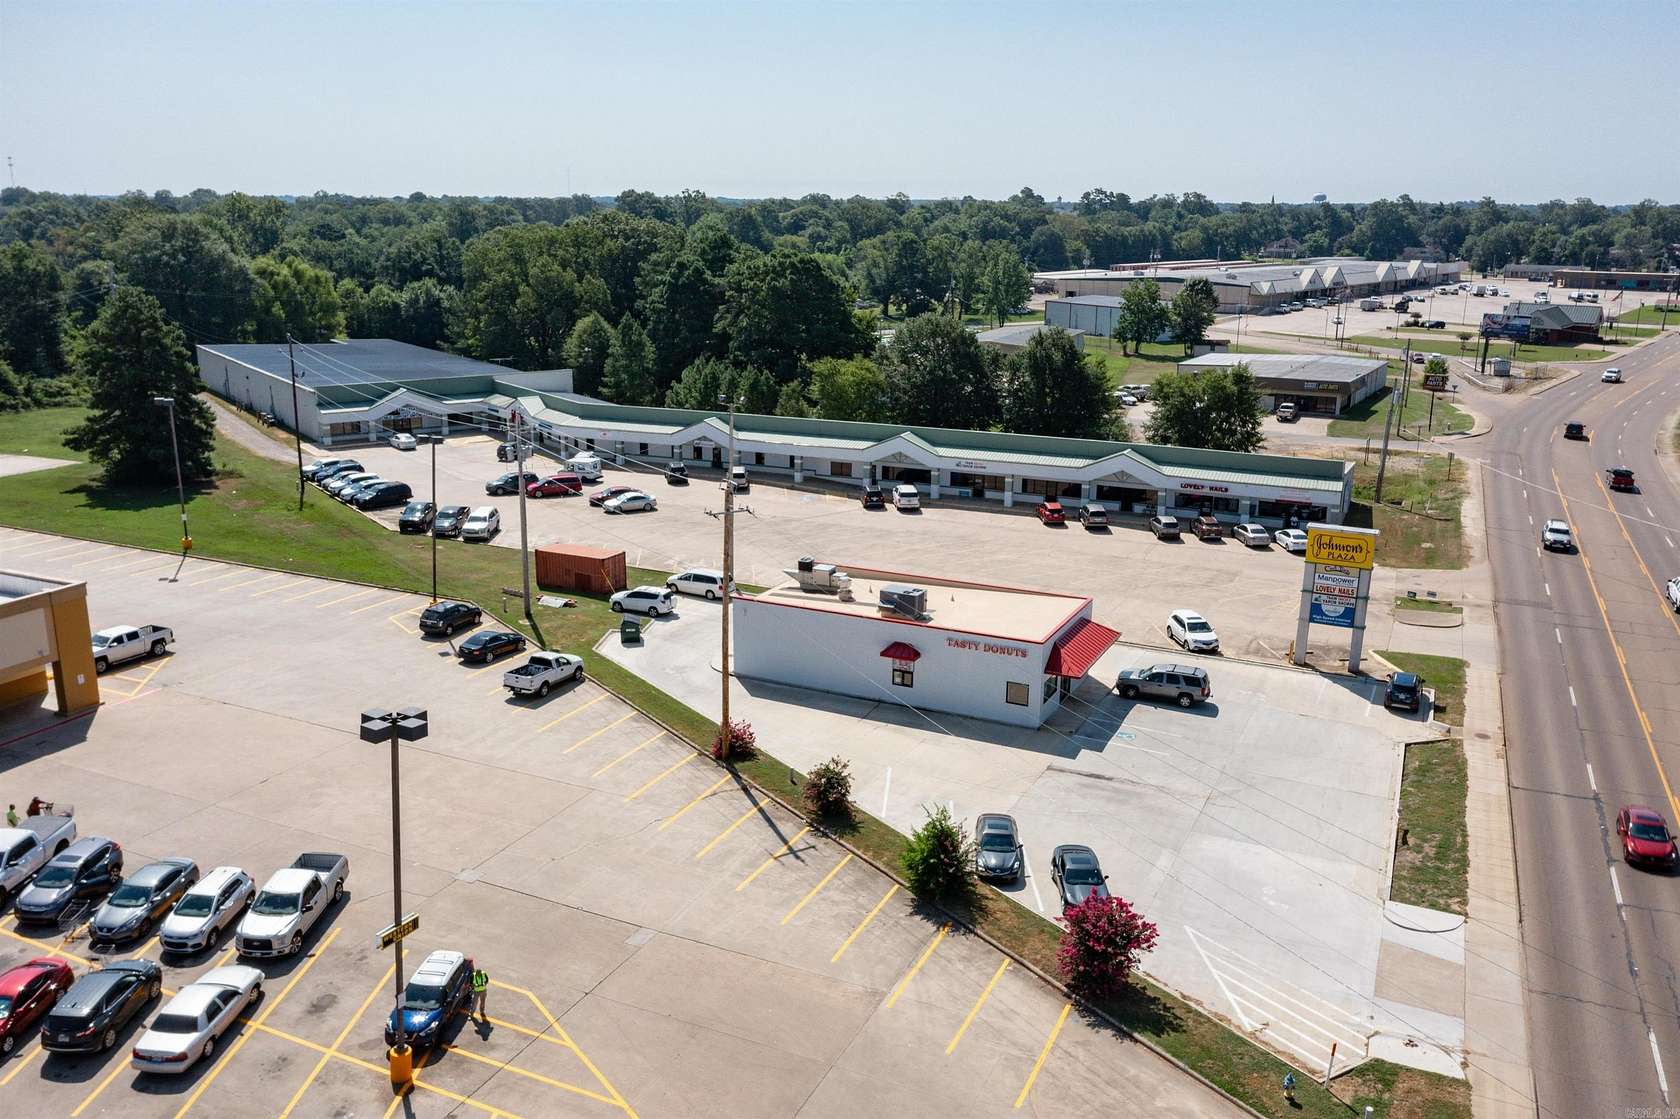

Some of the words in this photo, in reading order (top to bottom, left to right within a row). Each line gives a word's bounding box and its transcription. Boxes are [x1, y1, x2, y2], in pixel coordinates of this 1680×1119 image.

[1180, 482, 1204, 490] LOVELY
[1327, 552, 1356, 562] PLAZA
[1317, 574, 1355, 585] Manpower
[1315, 585, 1337, 594] LOVELY
[1337, 587, 1355, 596] NAILS
[946, 637, 981, 651] TASTY
[983, 642, 1028, 658] DONUTS
